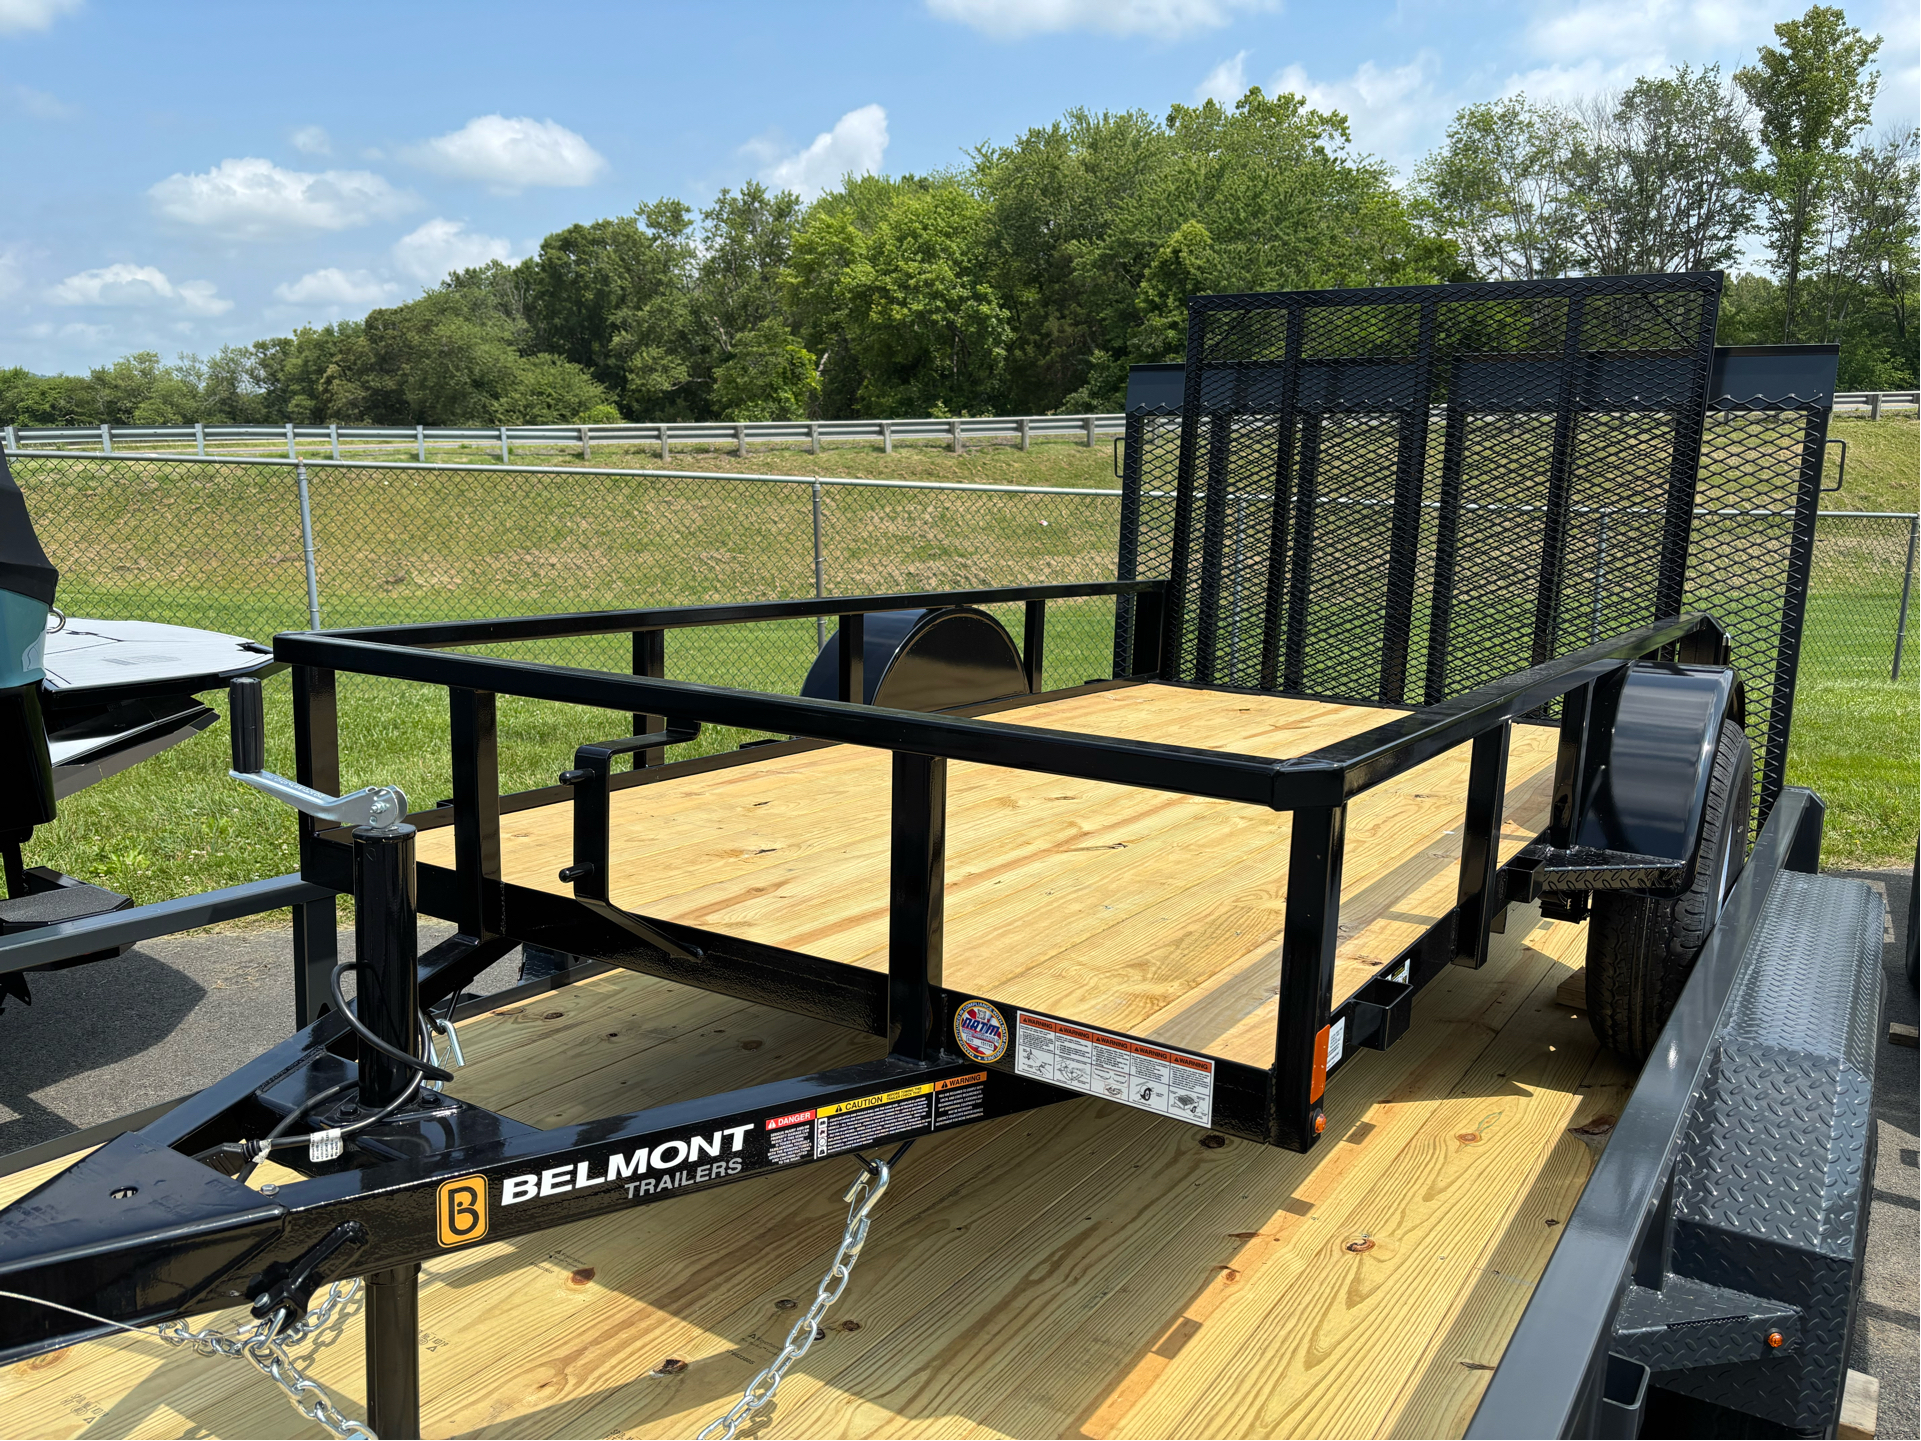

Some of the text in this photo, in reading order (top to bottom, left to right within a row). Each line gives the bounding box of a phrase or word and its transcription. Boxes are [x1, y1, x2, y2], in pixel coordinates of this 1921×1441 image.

[962, 1002, 992, 1011] COMPLIANCE
[992, 1010, 1002, 1024] WITH
[1028, 1018, 1053, 1029] WARNING
[1063, 1028, 1090, 1039] WARNING
[1101, 1038, 1128, 1049] WARNING
[1140, 1048, 1167, 1059] WARNING
[1179, 1058, 1208, 1069] WARNING
[949, 1074, 980, 1086] WARNING
[845, 1096, 883, 1110] CAUTION
[778, 1113, 810, 1125] DANGER
[501, 1123, 755, 1206] BELMONT
[625, 1158, 742, 1200] TRAILERS
